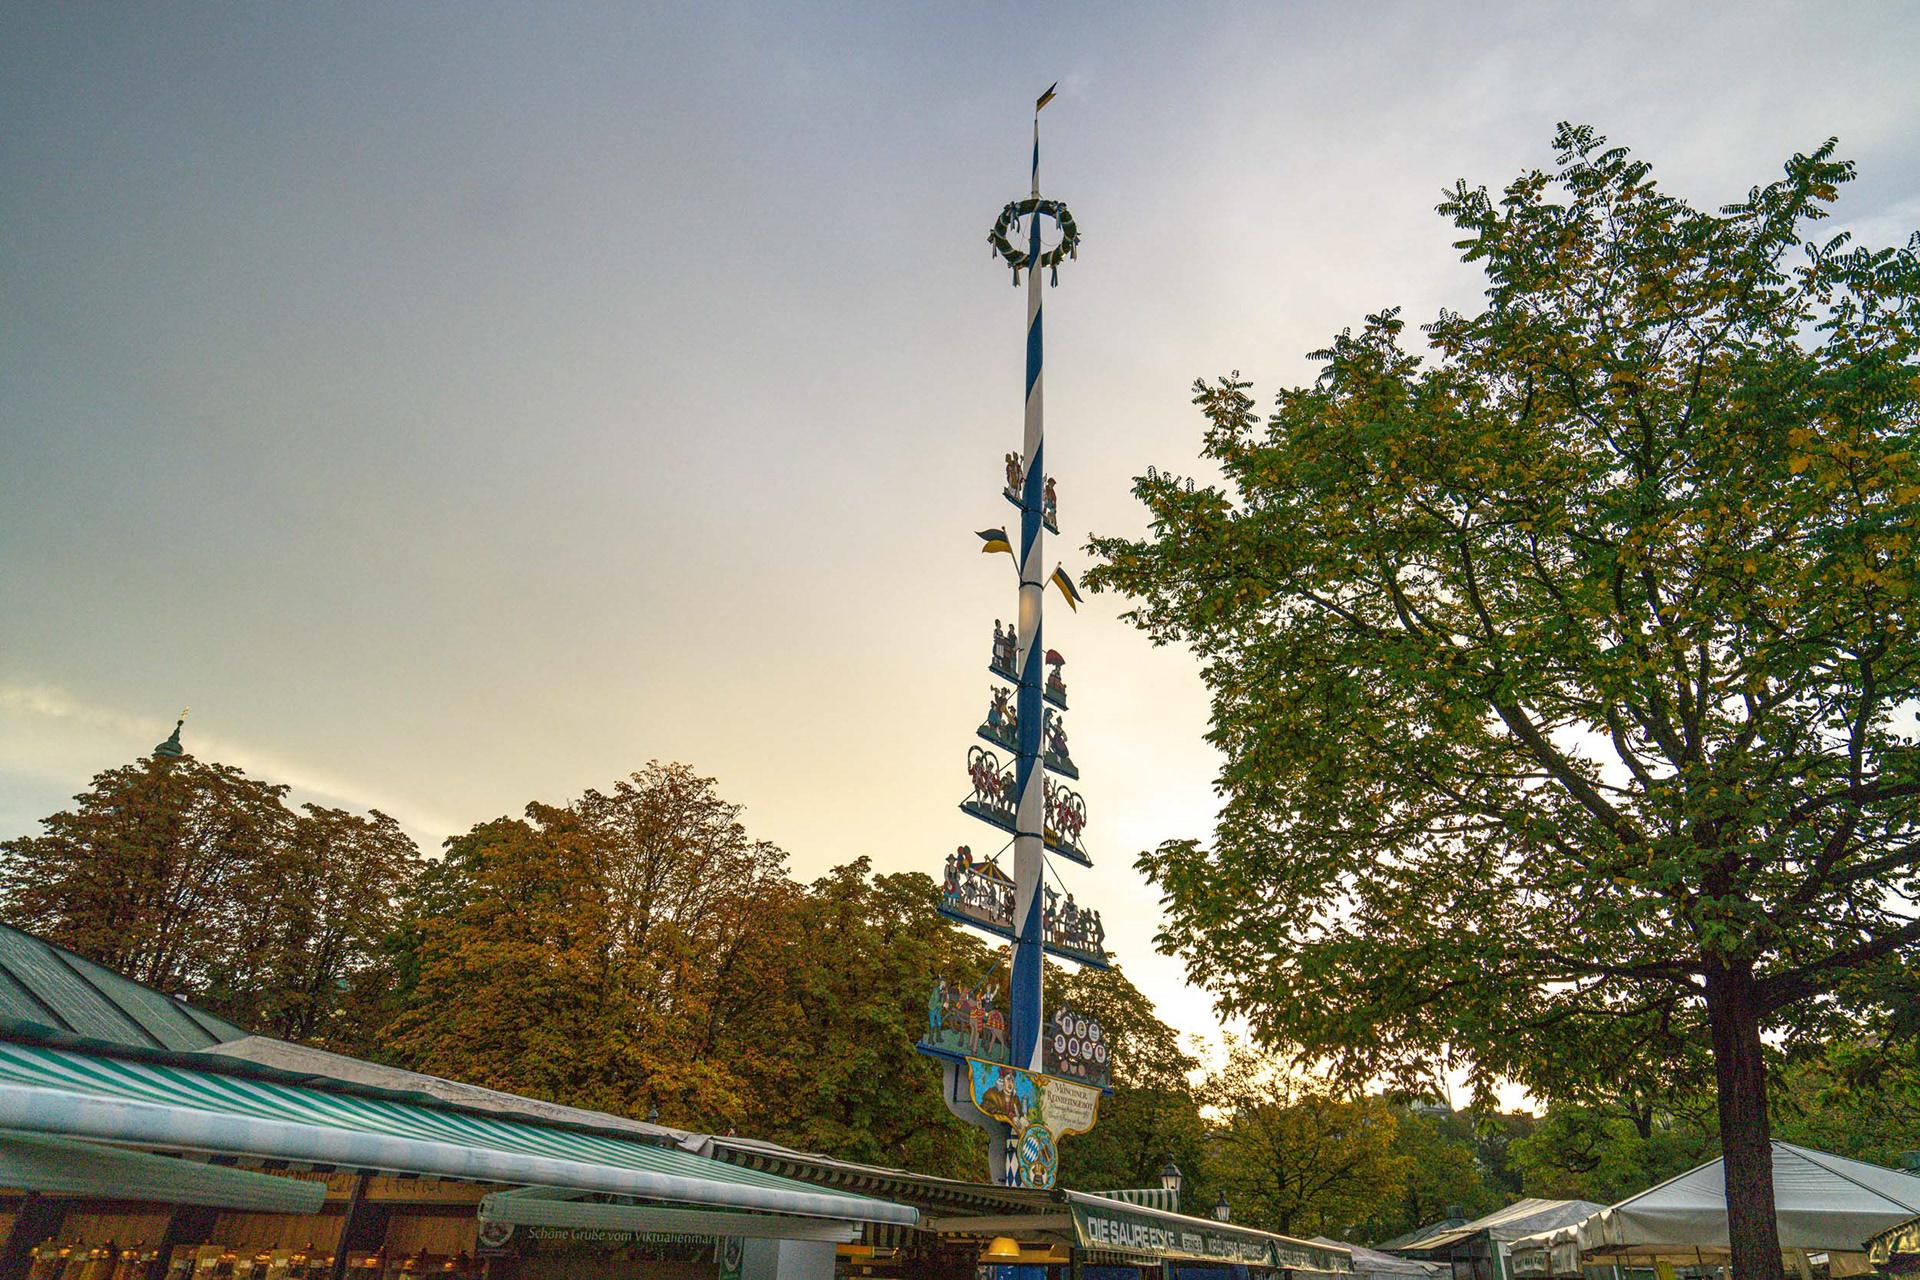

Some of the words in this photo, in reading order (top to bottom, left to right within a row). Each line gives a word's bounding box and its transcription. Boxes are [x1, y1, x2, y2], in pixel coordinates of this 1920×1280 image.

[528, 1226, 569, 1240] Schöne
[571, 1228, 606, 1241] Grüße
[607, 1232, 632, 1242] vom
[635, 1231, 716, 1244] Viktualienmar
